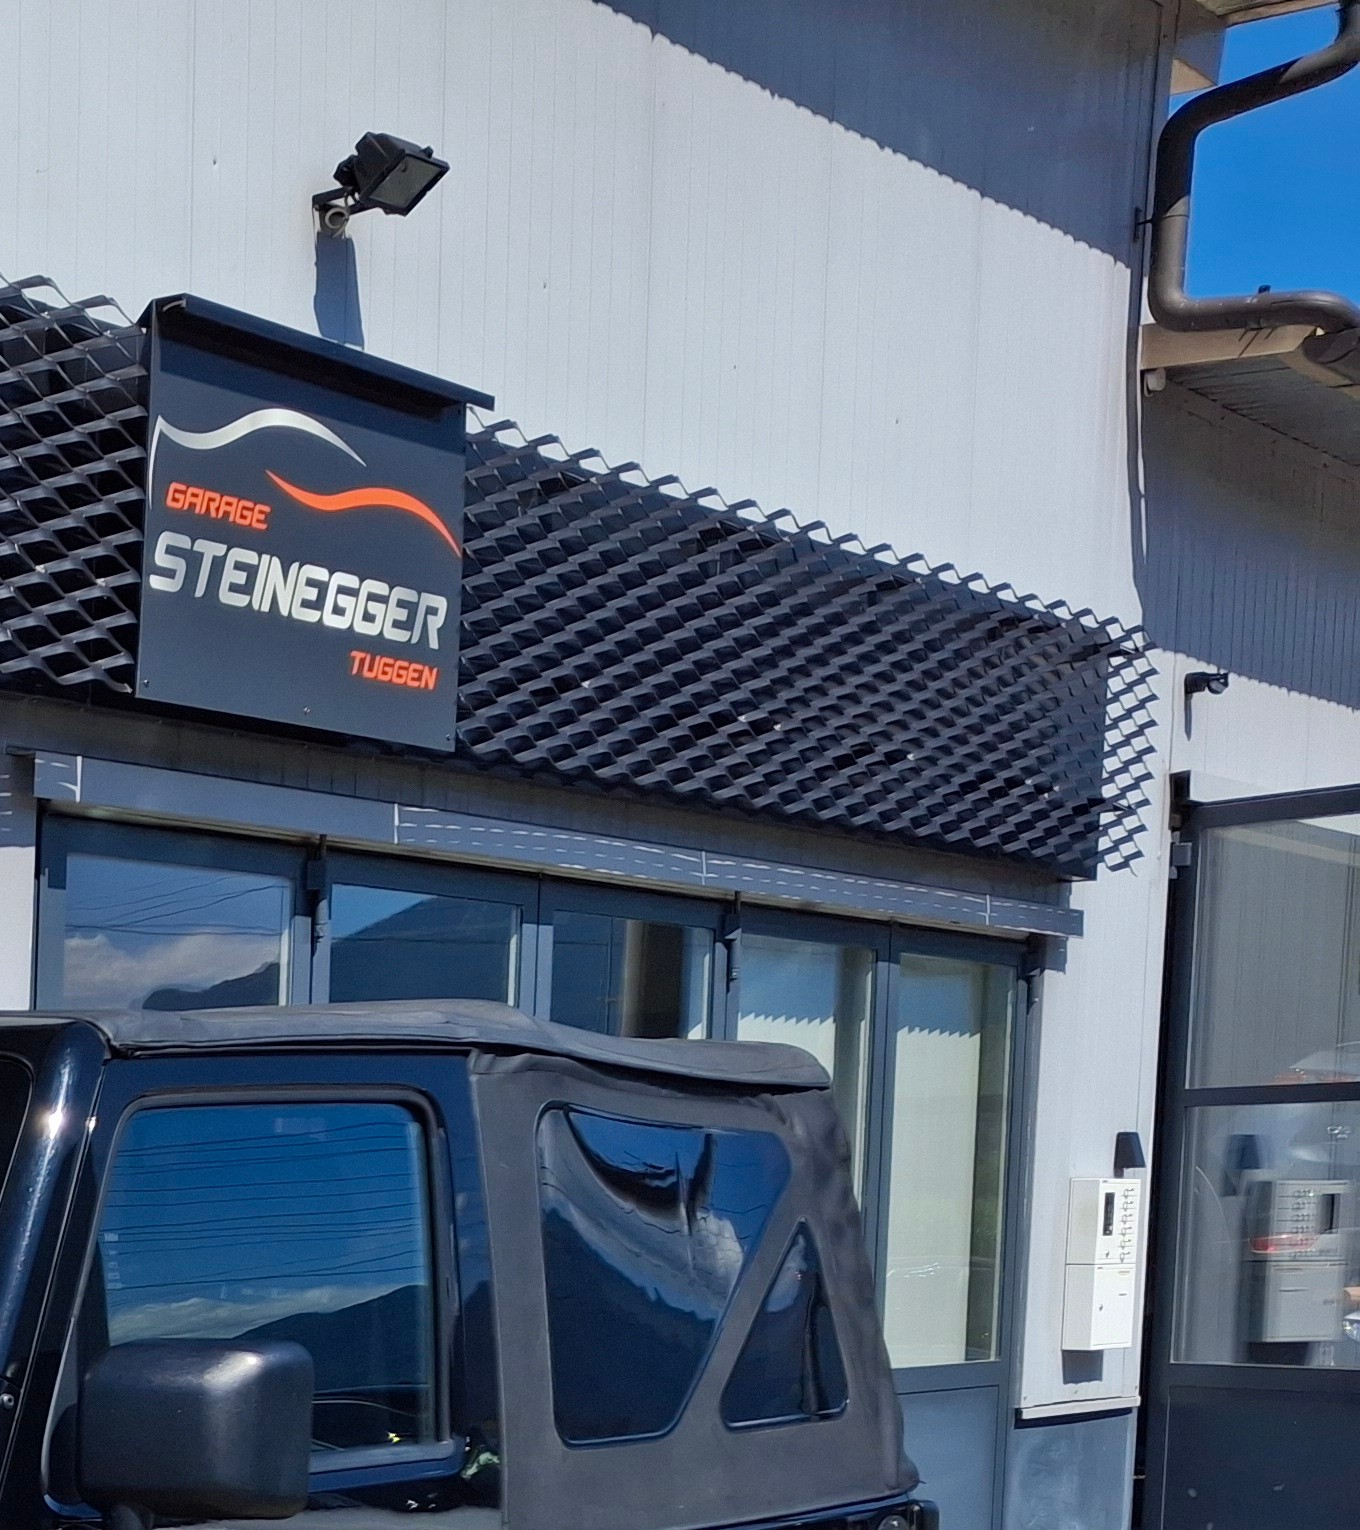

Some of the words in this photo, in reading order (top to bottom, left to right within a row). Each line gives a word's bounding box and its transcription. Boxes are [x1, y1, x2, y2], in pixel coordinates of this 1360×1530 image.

[165, 482, 271, 530] GARAGE
[149, 531, 447, 650] STEINEGGER
[350, 651, 438, 690] TUGGEN
